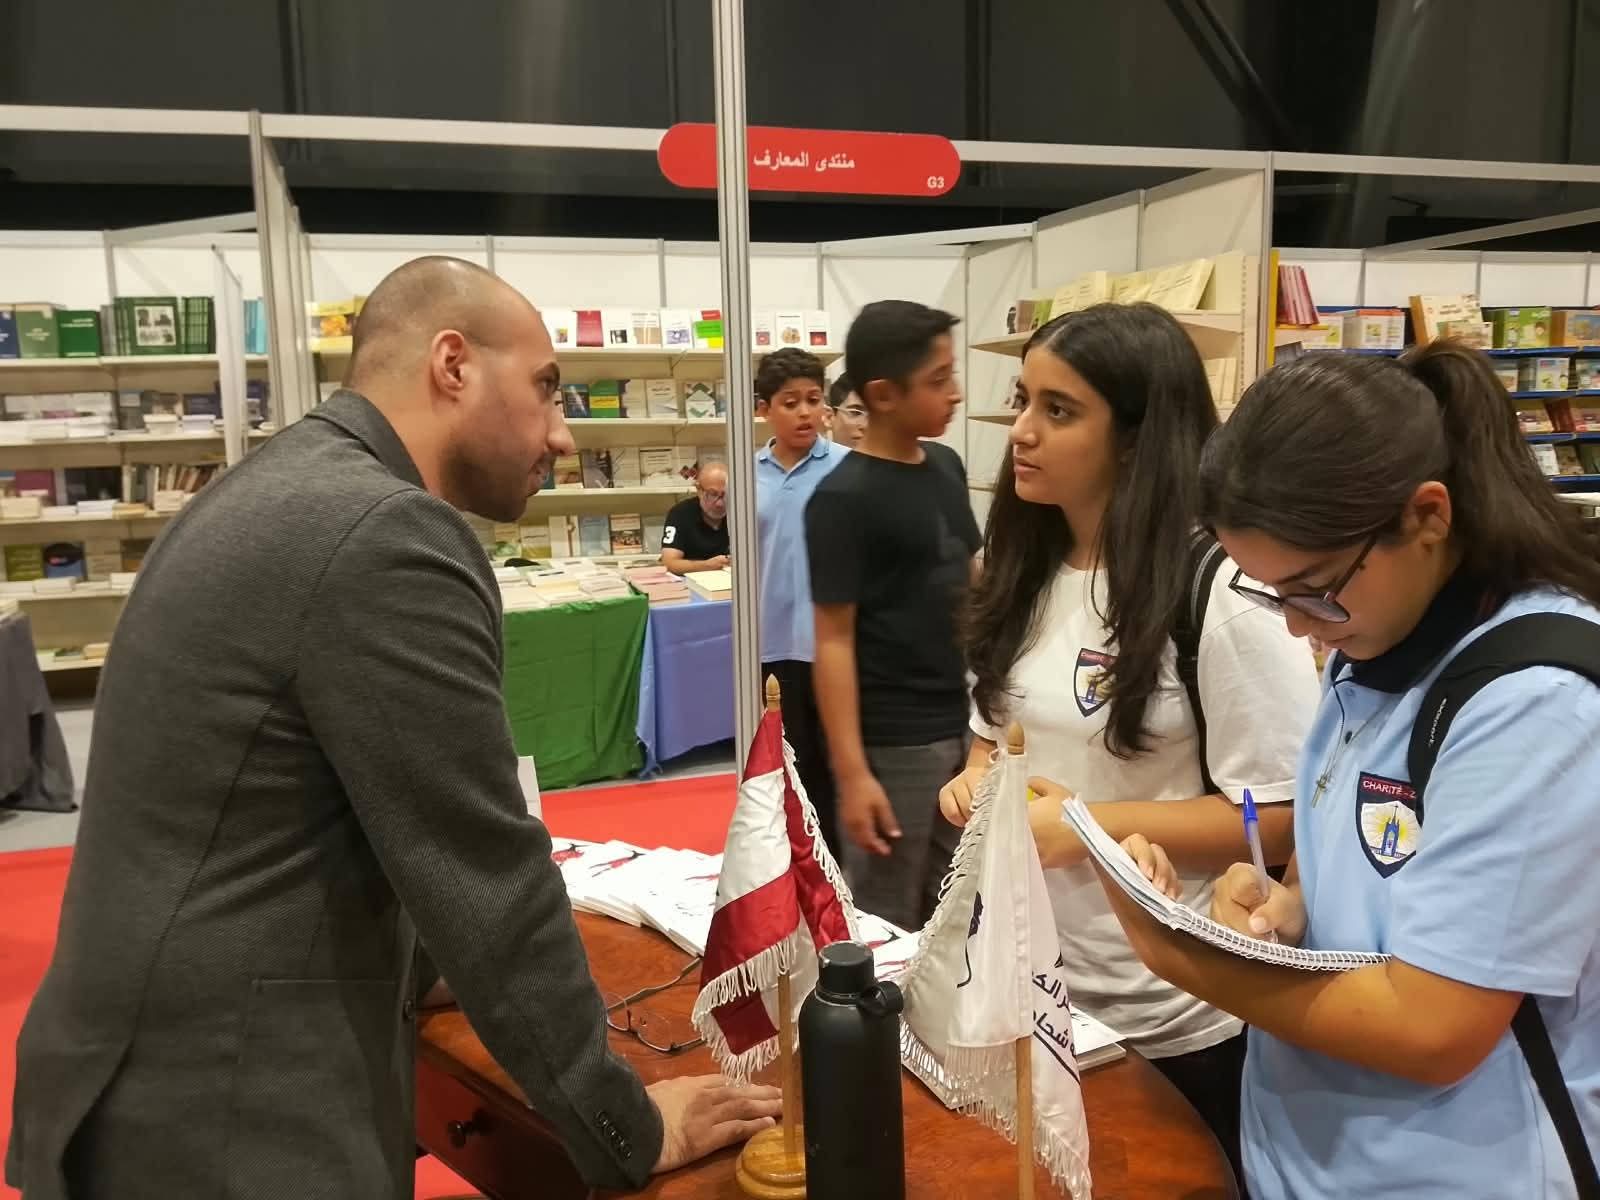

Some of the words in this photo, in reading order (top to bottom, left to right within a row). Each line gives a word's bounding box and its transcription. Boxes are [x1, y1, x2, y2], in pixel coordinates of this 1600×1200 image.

[753, 149, 809, 170] المعارف
[815, 153, 855, 171] منتدى
[927, 176, 945, 189] G3
[662, 525, 677, 545] 3
